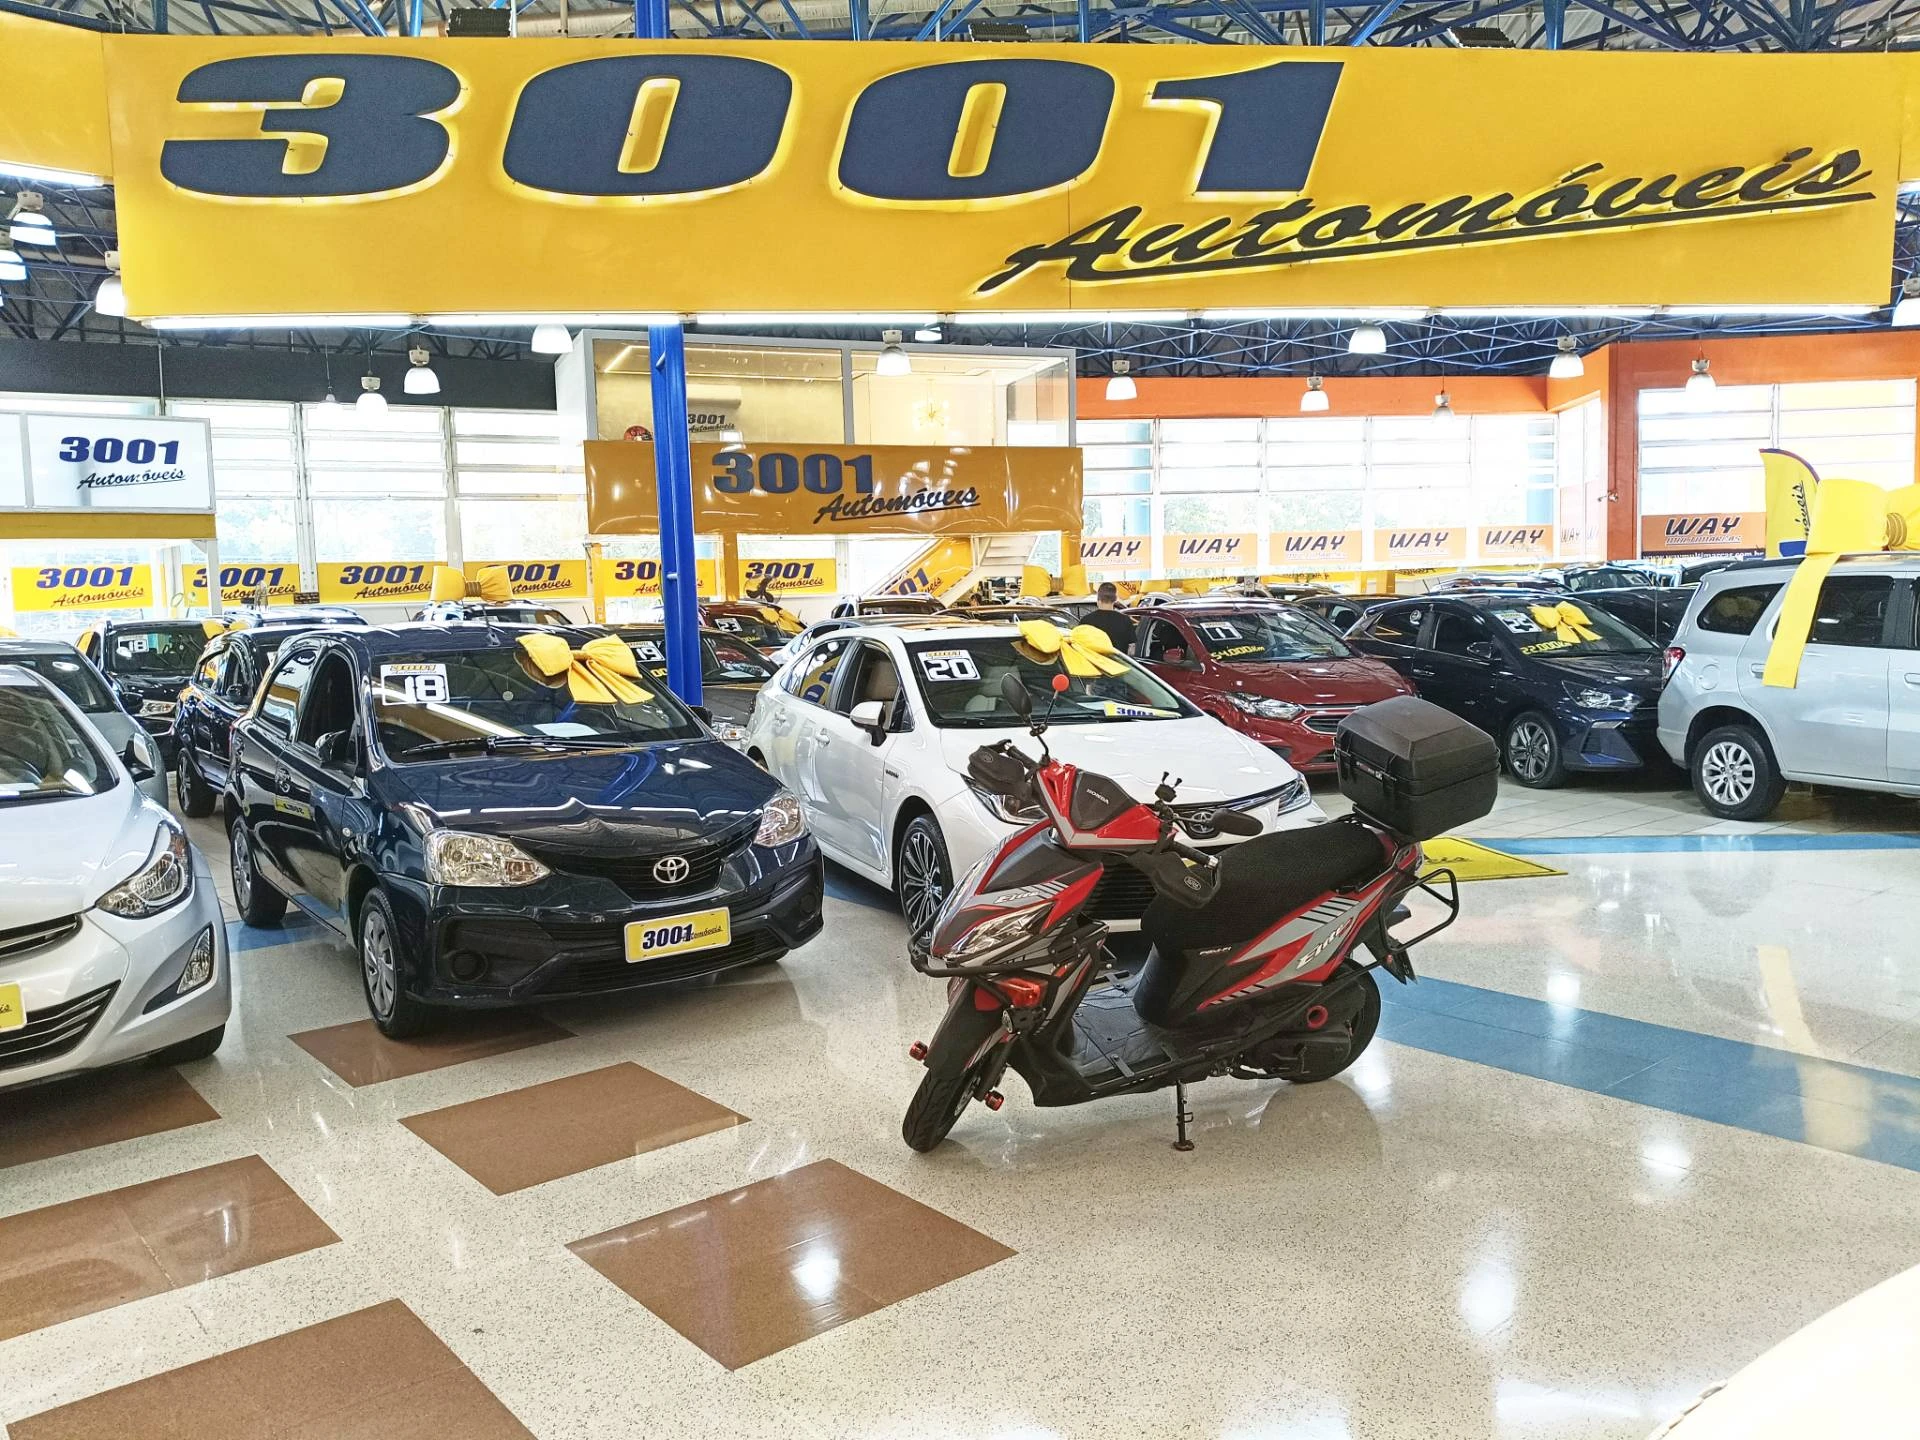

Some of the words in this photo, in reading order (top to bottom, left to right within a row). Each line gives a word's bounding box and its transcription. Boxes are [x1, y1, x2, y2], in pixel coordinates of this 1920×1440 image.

[160, 53, 1344, 198] 3001
[976, 147, 1876, 294] Automóveis
[688, 414, 725, 425] 3001
[59, 436, 180, 465] 3001
[76, 468, 187, 489] Automóveis
[712, 452, 873, 494] 3001
[813, 486, 981, 523] Automóveis
[1664, 516, 1741, 535] WAY
[1178, 538, 1240, 554] WAY
[1285, 535, 1345, 551] WAY
[1389, 532, 1449, 548] WAY
[1485, 529, 1544, 545] WAY
[1080, 540, 1142, 557] WAY
[36, 567, 133, 588] 3001
[340, 565, 424, 585] 3001
[745, 562, 815, 579] 3001
[51, 587, 145, 607] Automóveis
[636, 647, 662, 662] 19
[924, 660, 978, 679] 20
[404, 675, 447, 703] 18
[1086, 789, 1109, 805] HONDA
[642, 923, 693, 950] 3001
